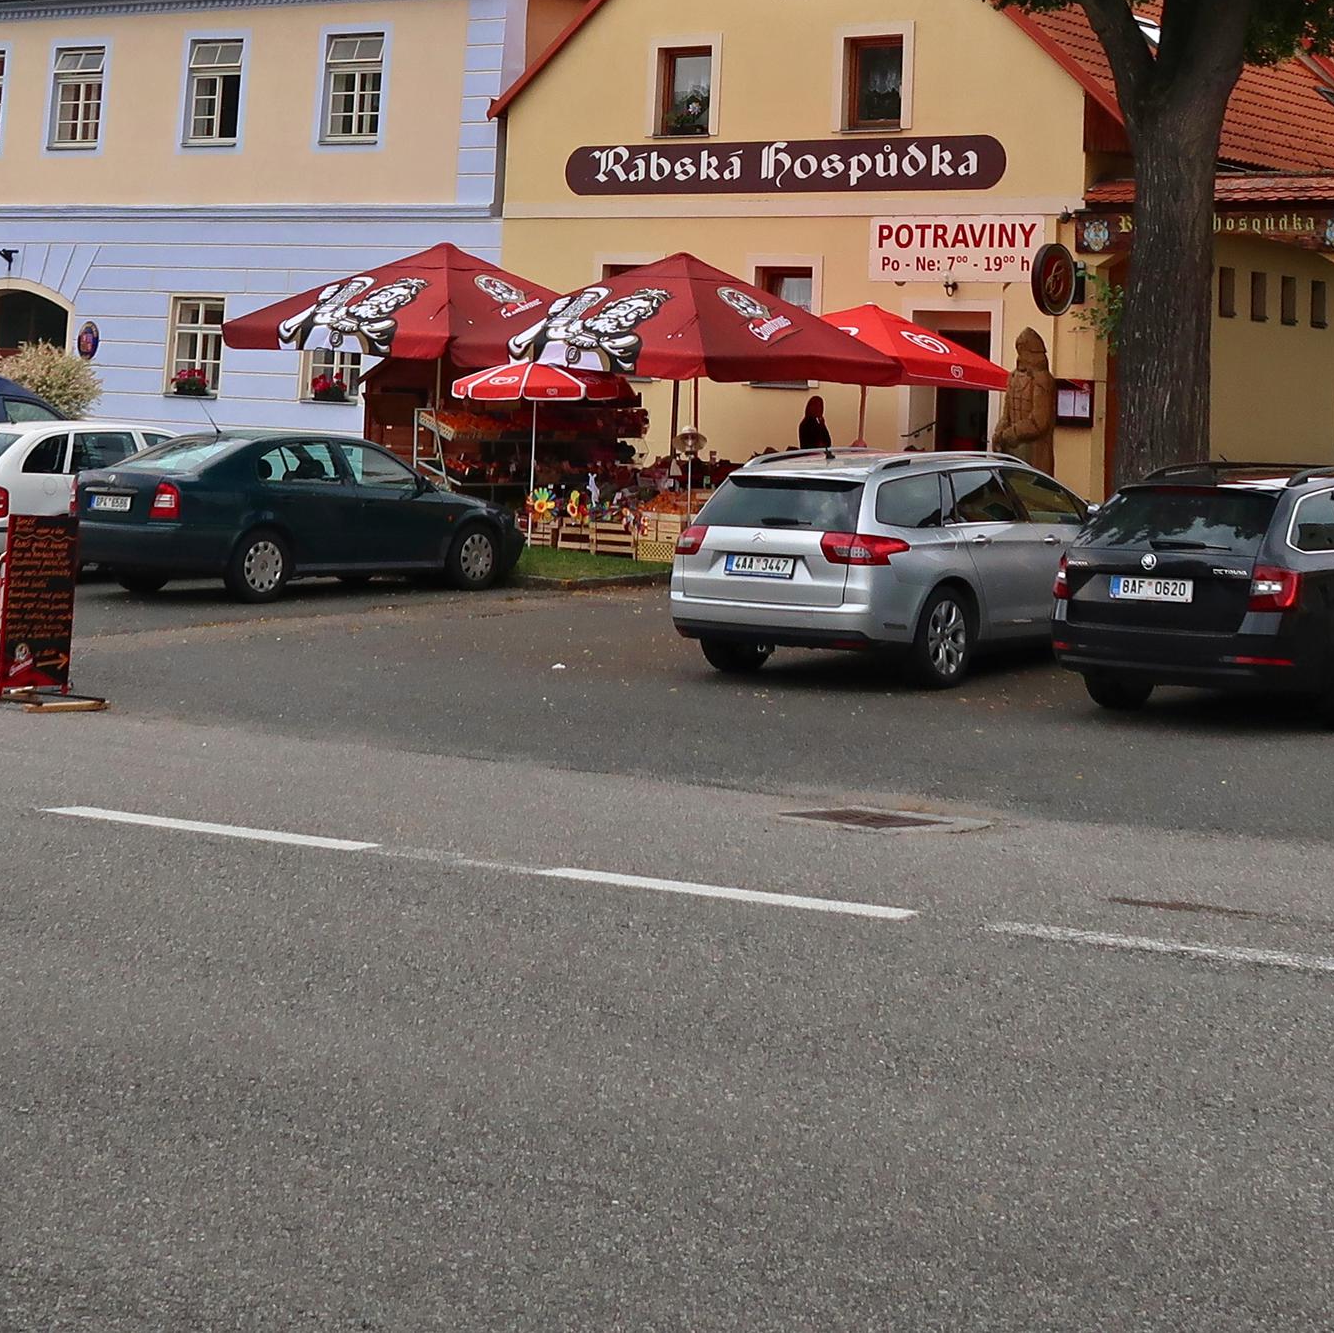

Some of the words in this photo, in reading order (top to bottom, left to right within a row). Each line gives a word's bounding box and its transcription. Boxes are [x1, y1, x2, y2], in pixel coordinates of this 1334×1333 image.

[588, 145, 744, 182] Rábská
[760, 140, 979, 188] Hospůdka
[877, 223, 1038, 249] POTRAVINY
[881, 256, 900, 272] Po
[915, 256, 942, 272] Ne:
[1020, 255, 1030, 272] h
[734, 556, 755, 571] 4AA
[761, 558, 789, 573] 3447
[1122, 579, 1146, 595] 8AF
[1154, 581, 1187, 597] 0620
